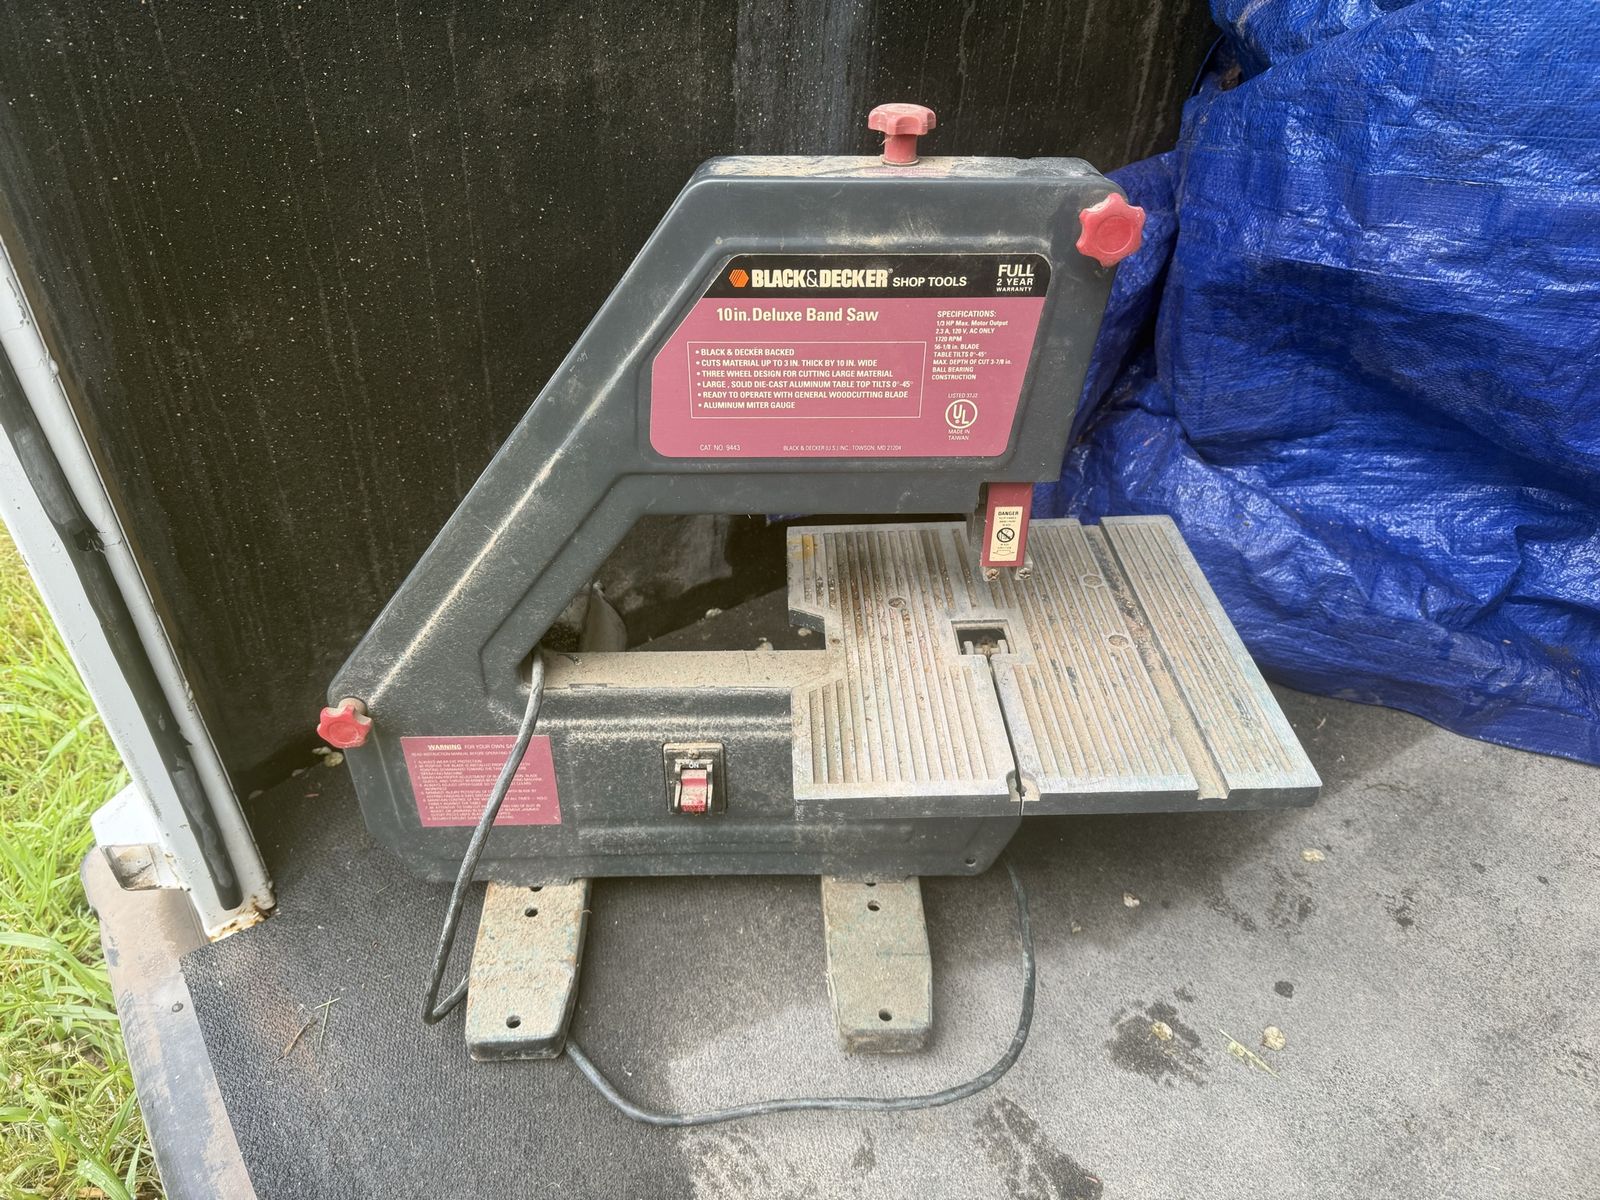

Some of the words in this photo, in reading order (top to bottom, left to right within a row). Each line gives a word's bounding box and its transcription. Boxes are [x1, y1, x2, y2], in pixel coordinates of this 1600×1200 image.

[998, 264, 1035, 277] FULL
[892, 276, 925, 287] SHOP
[928, 276, 967, 287] TOOLS
[997, 278, 1002, 286] 2
[1007, 278, 1034, 286] YEAR
[752, 307, 803, 322] Deluxe
[806, 307, 843, 322] Band
[846, 307, 879, 322] Saw
[937, 309, 997, 318] SPECIFICATIONS:
[701, 359, 721, 367] CUTS
[722, 359, 760, 367] MATERIAL
[761, 359, 771, 367] UP
[773, 359, 783, 367] TO
[784, 359, 789, 367] 3
[789, 359, 800, 367] IN.
[802, 359, 823, 367] THICK
[824, 359, 835, 367] BY
[837, 359, 845, 367] 10
[845, 359, 856, 367] IN.
[857, 359, 878, 367] WIDE
[703, 401, 745, 409] ALUMINUM
[746, 401, 769, 409] MITER
[770, 401, 796, 409] GAUGE
[952, 404, 970, 425] UL
[427, 743, 462, 751] WARNING
